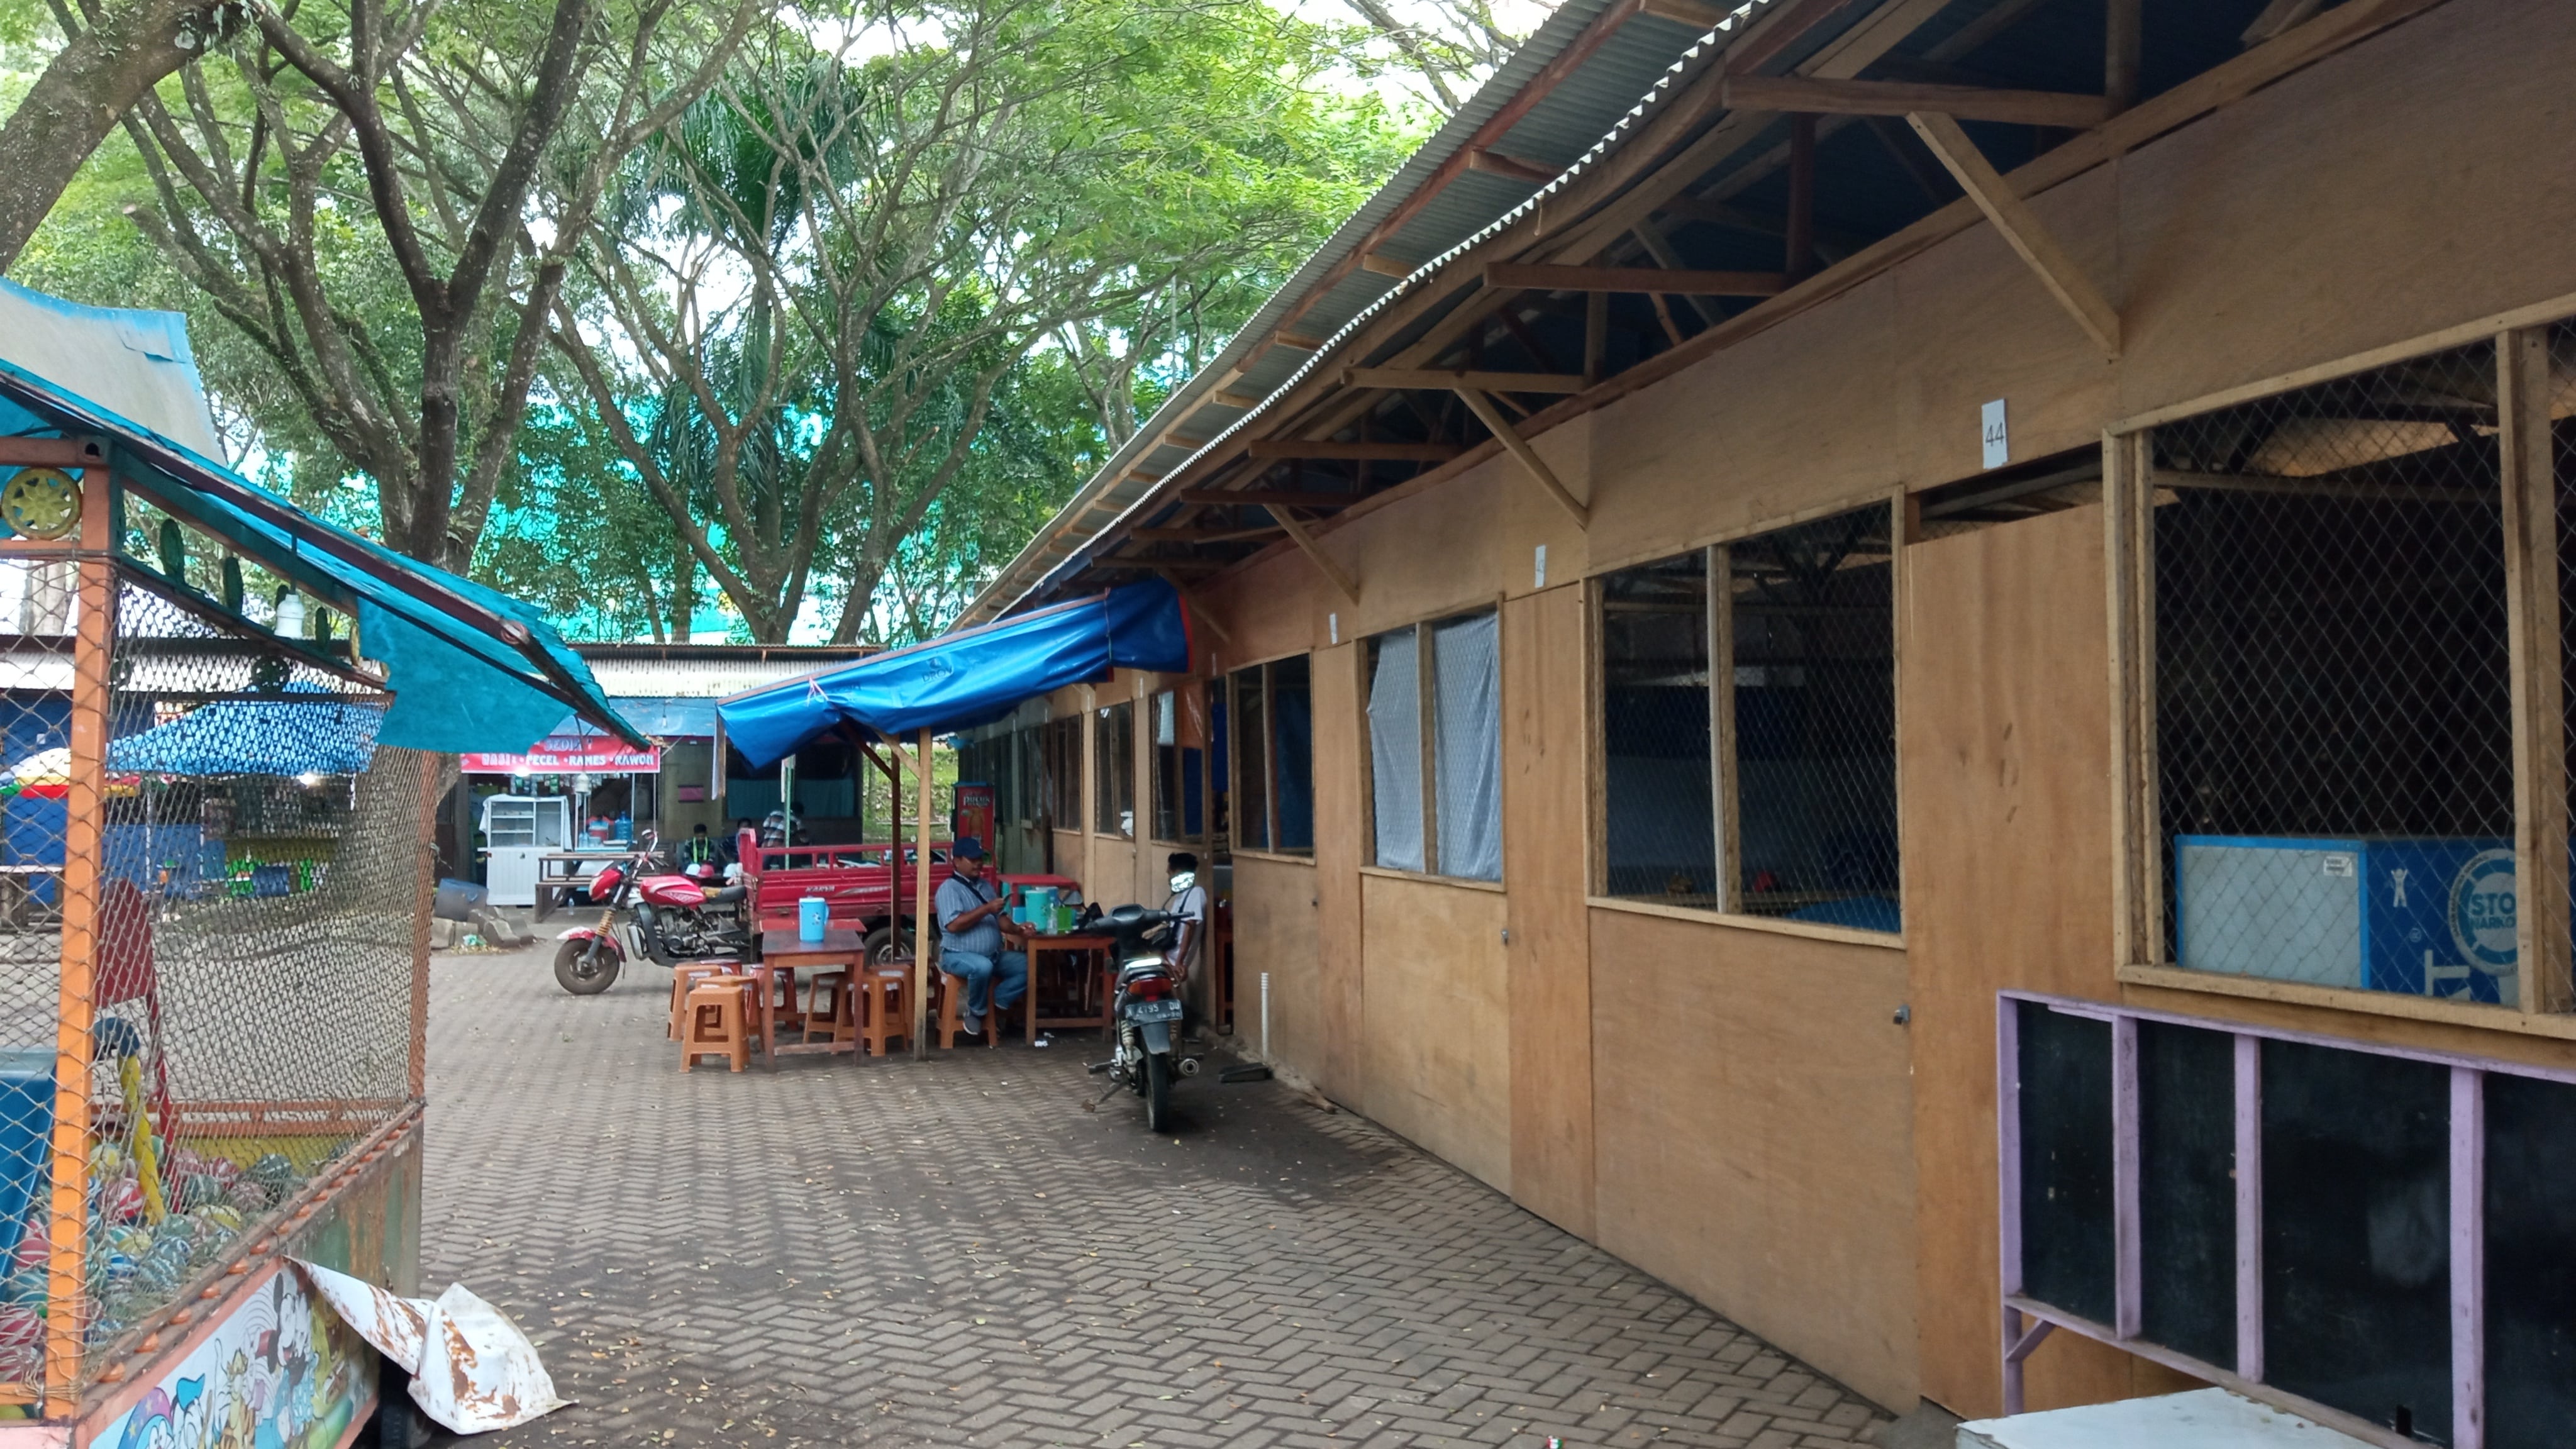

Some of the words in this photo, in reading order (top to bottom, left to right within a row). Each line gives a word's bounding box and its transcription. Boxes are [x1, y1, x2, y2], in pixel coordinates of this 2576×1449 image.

[1985, 422, 2004, 447] 44
[526, 755, 559, 766] PECEL
[569, 755, 606, 766] RAMES
[615, 755, 654, 766] RAWON
[2471, 892, 2516, 915] STO
[2469, 916, 2516, 930] NARKO
